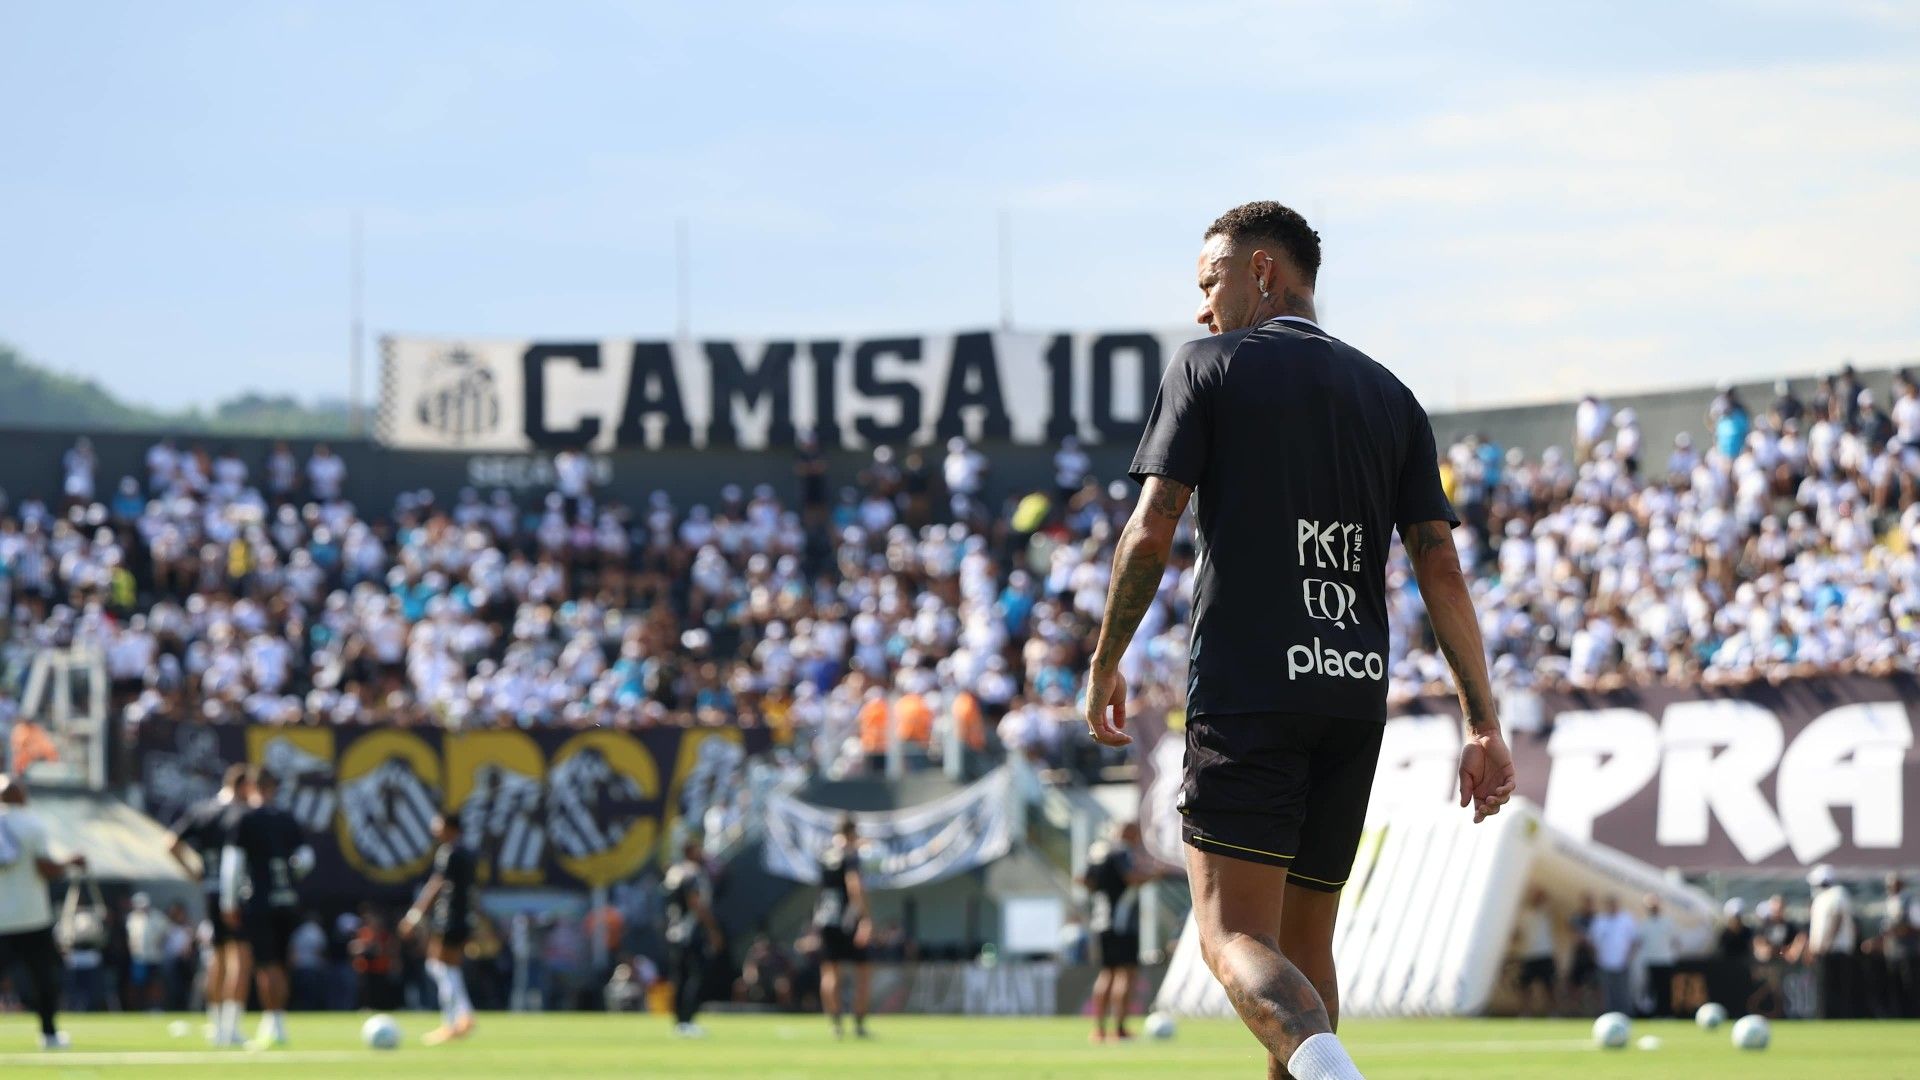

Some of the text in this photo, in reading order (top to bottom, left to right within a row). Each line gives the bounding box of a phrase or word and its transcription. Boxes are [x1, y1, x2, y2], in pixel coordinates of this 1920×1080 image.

[522, 331, 1162, 450] CAMISA 10
[1352, 554, 1361, 572] BY
[1302, 578, 1361, 630] EQR
[1286, 636, 1384, 681] placo
[1545, 700, 1913, 864] PRA
